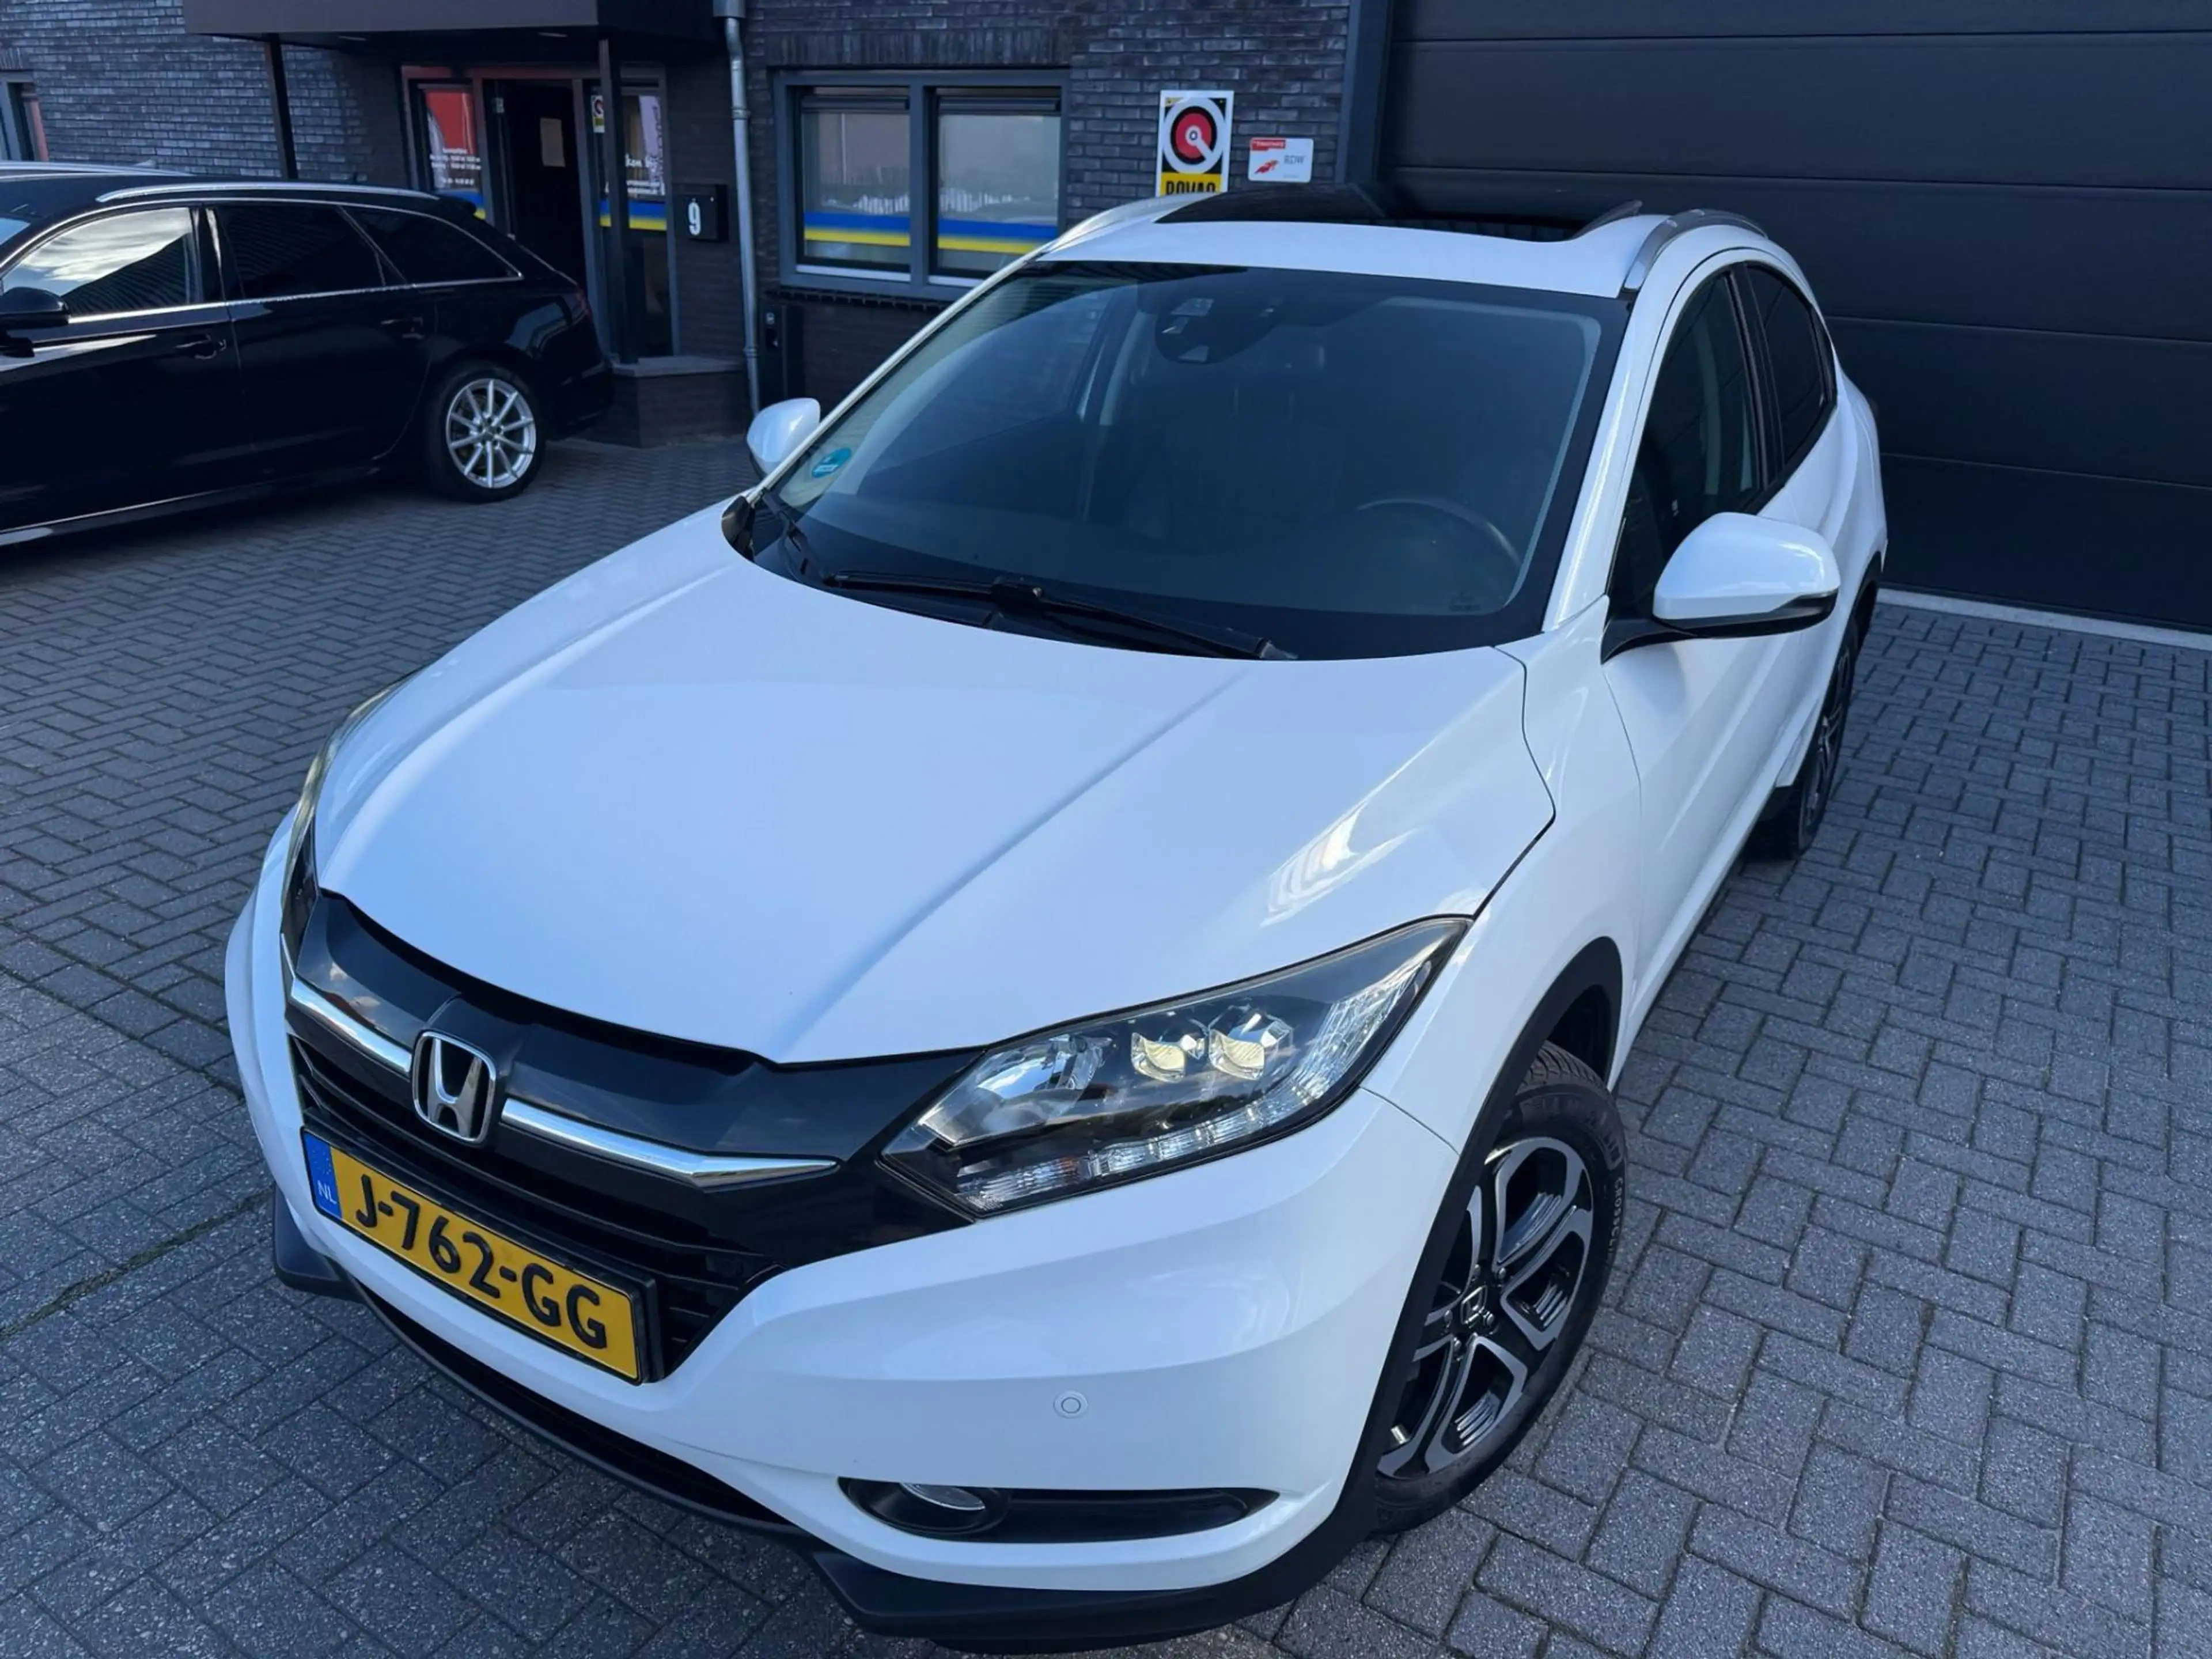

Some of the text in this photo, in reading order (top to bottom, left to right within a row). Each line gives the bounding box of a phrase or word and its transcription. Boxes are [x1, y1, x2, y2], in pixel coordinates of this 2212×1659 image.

[688, 202, 701, 236] 9
[317, 1180, 337, 1205] NL
[355, 1175, 607, 1349] J-762-GG
